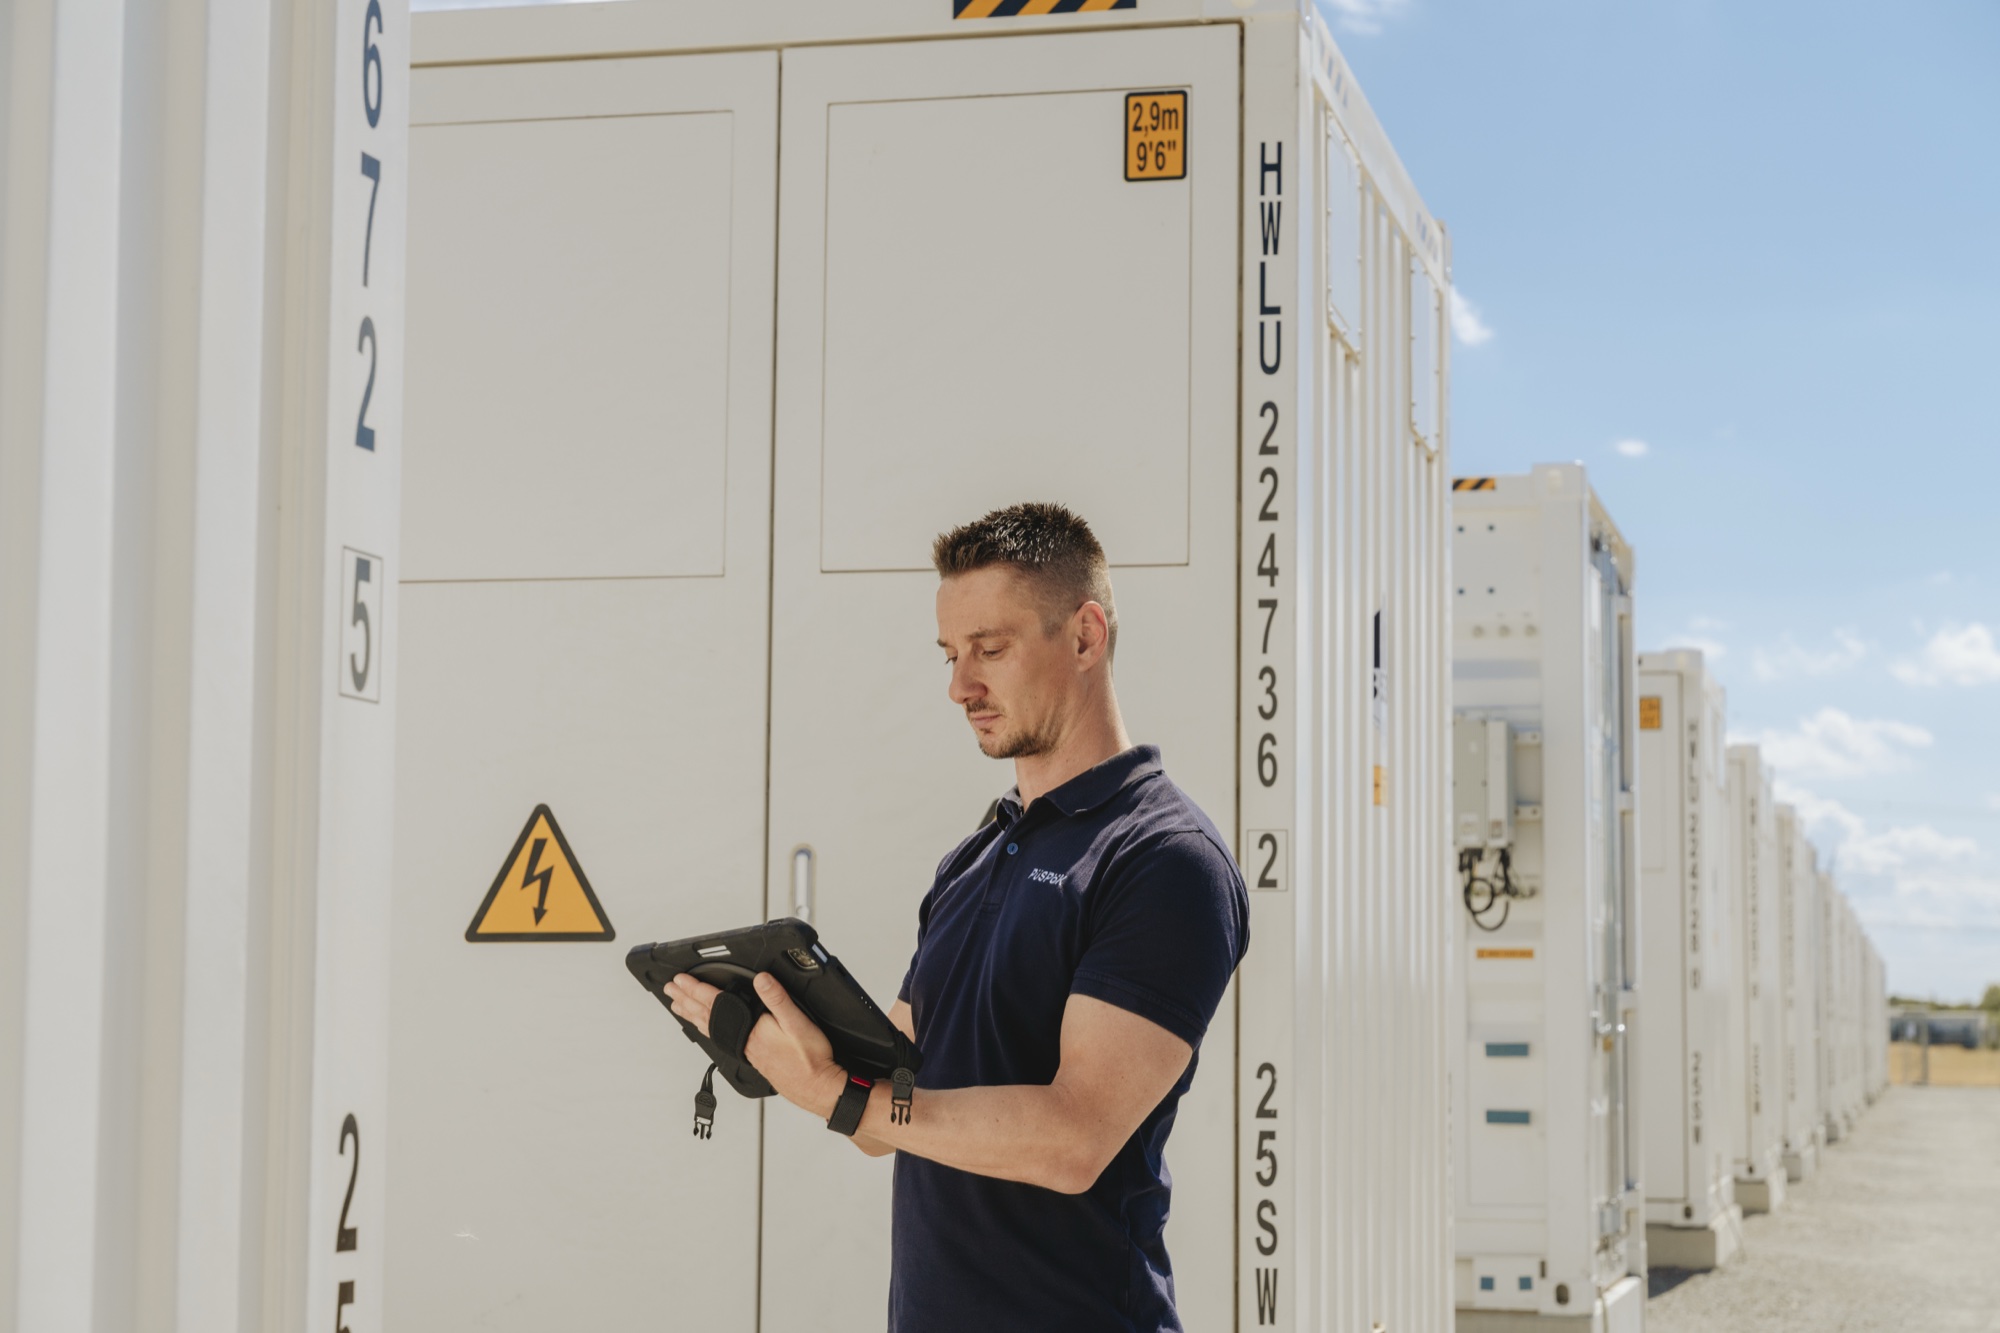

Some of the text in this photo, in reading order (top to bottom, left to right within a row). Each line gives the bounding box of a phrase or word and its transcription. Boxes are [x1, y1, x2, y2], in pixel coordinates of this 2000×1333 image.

[1132, 101, 1179, 137] 2,9m
[1136, 140, 1177, 172] 9'6"
[1257, 142, 1283, 888] HWLU 224736 2
[350, 557, 371, 692] 5
[1255, 1062, 1278, 1326] 25SW
